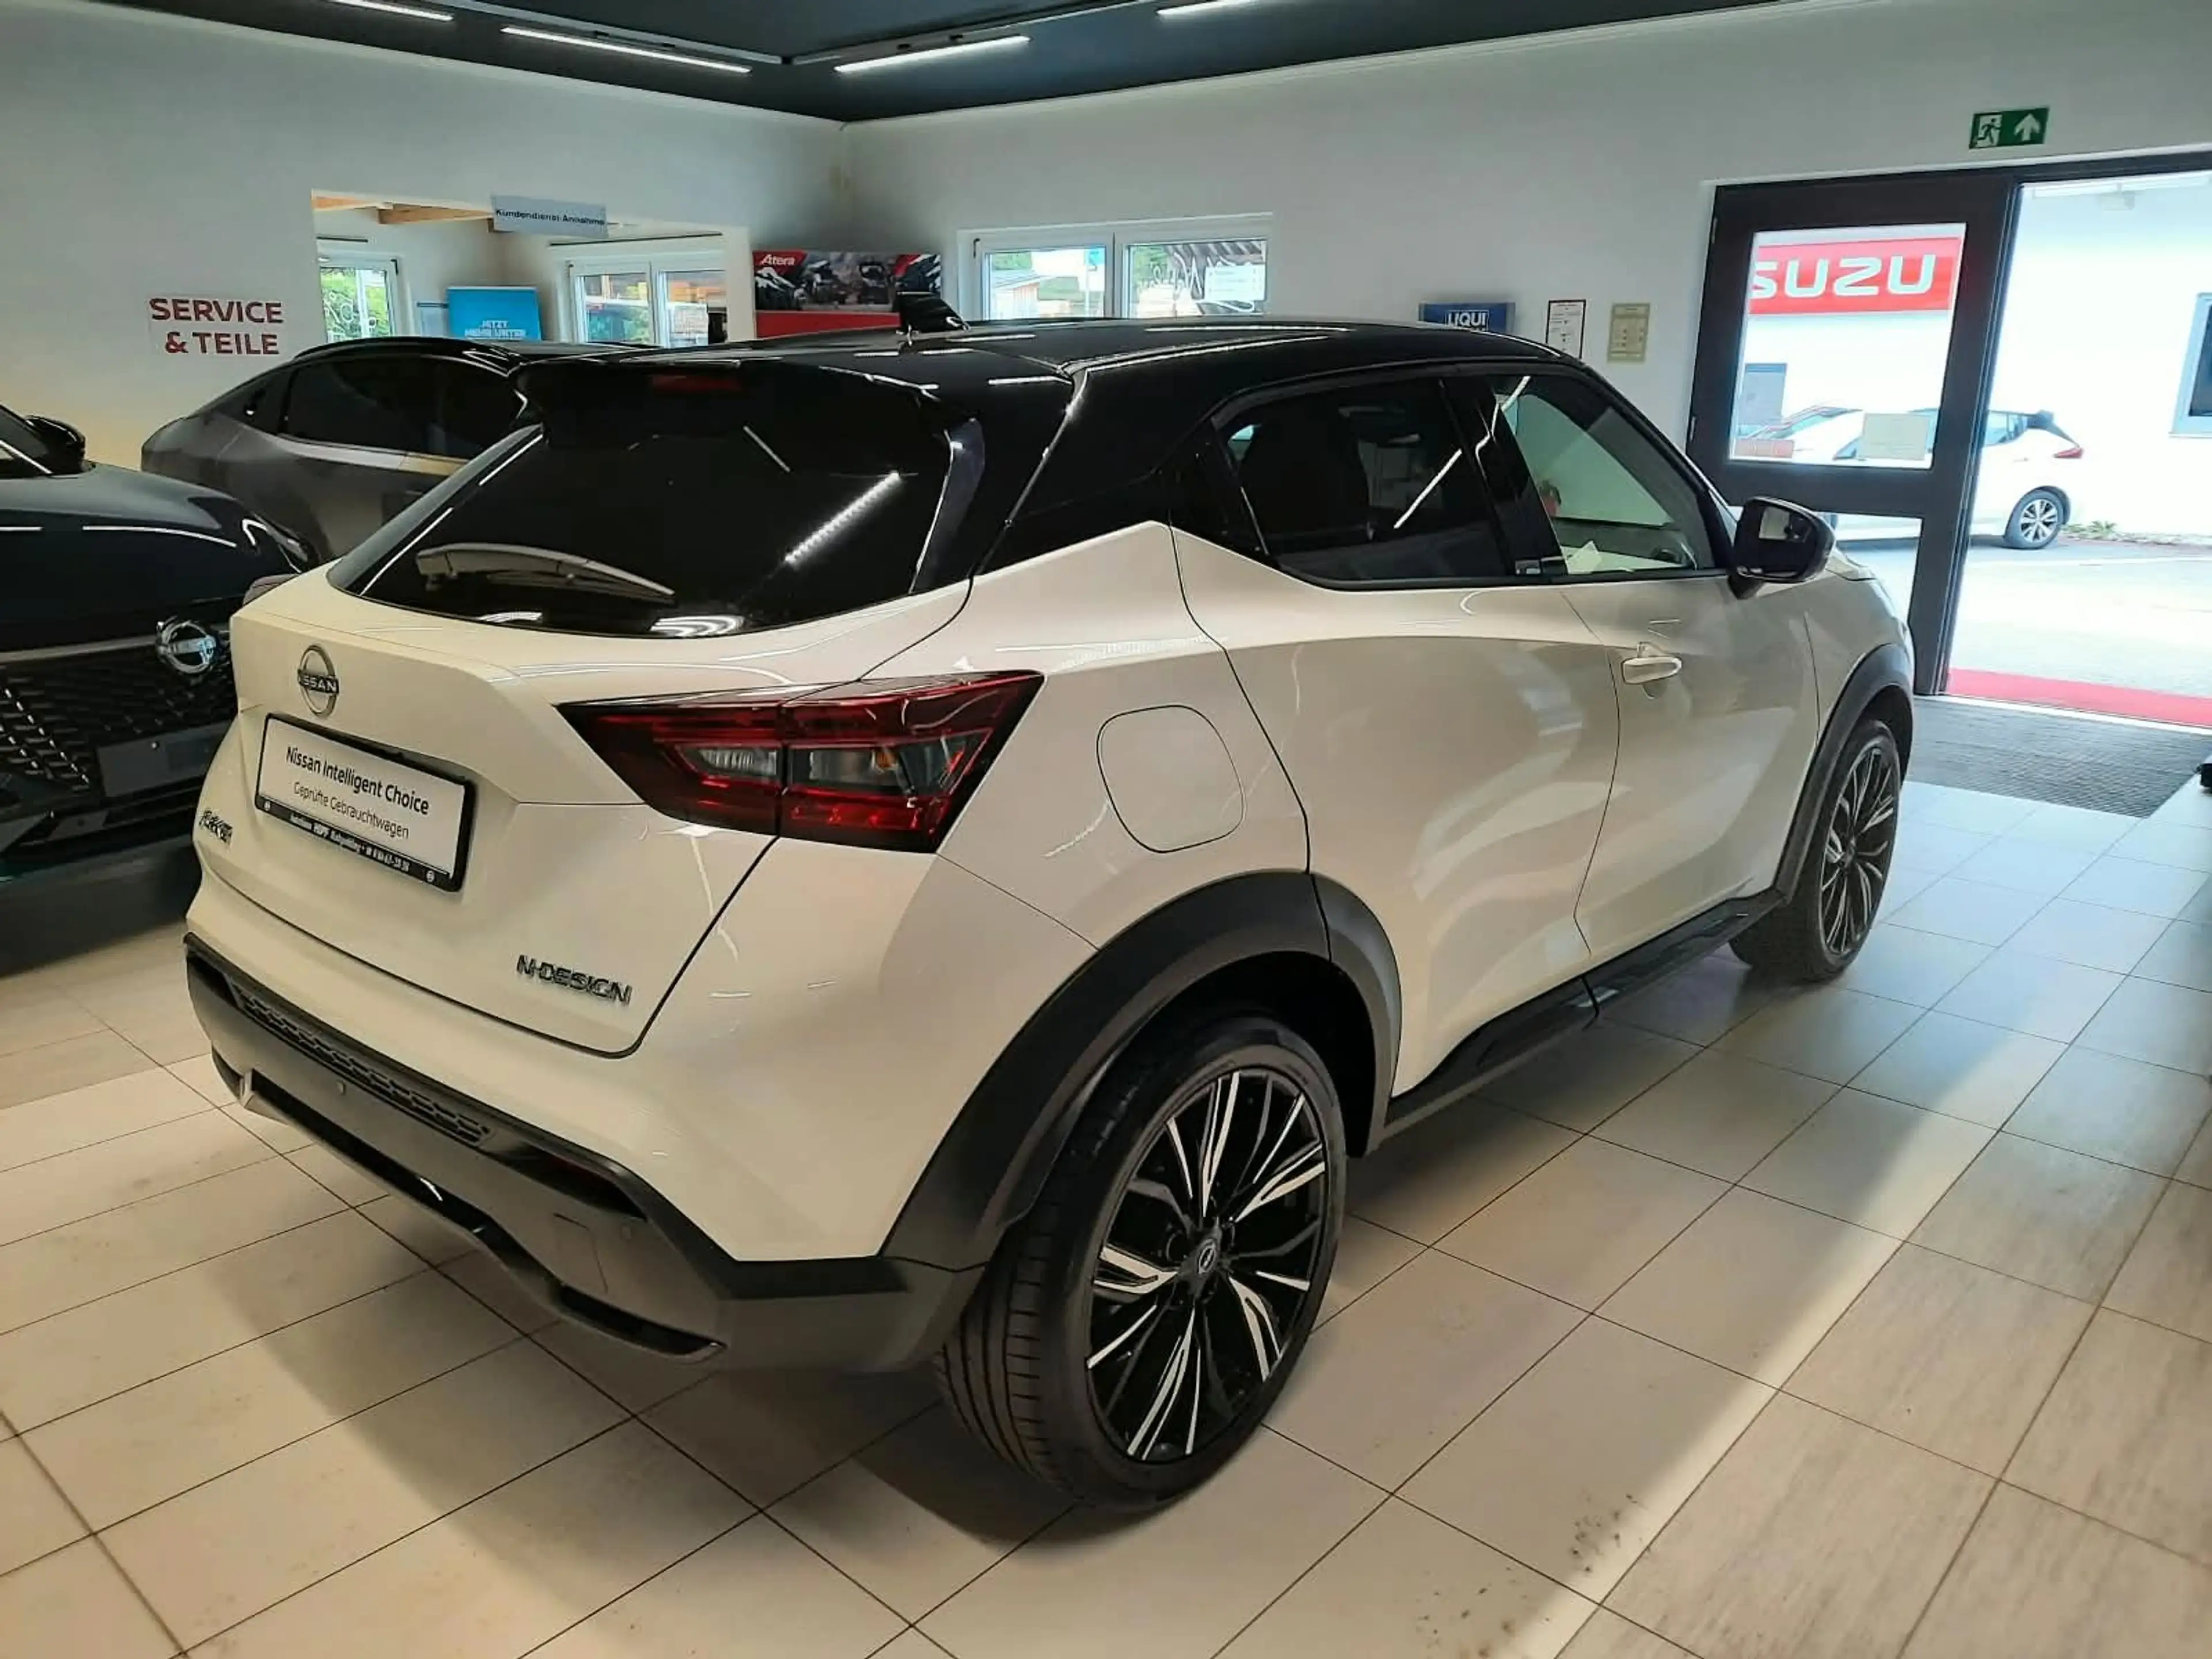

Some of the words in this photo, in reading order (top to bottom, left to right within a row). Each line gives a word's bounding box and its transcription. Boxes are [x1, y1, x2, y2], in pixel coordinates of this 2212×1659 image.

[149, 298, 283, 323] SERVICE
[1448, 312, 1486, 327] LIQUI
[165, 331, 188, 354] &
[192, 332, 279, 355] TEILE
[286, 747, 321, 772] Nissan
[323, 759, 382, 797] Intelligent
[385, 783, 429, 815] Choice
[330, 797, 409, 839] Gebrauchtwagen
[517, 954, 632, 1006] N-DESIGN
